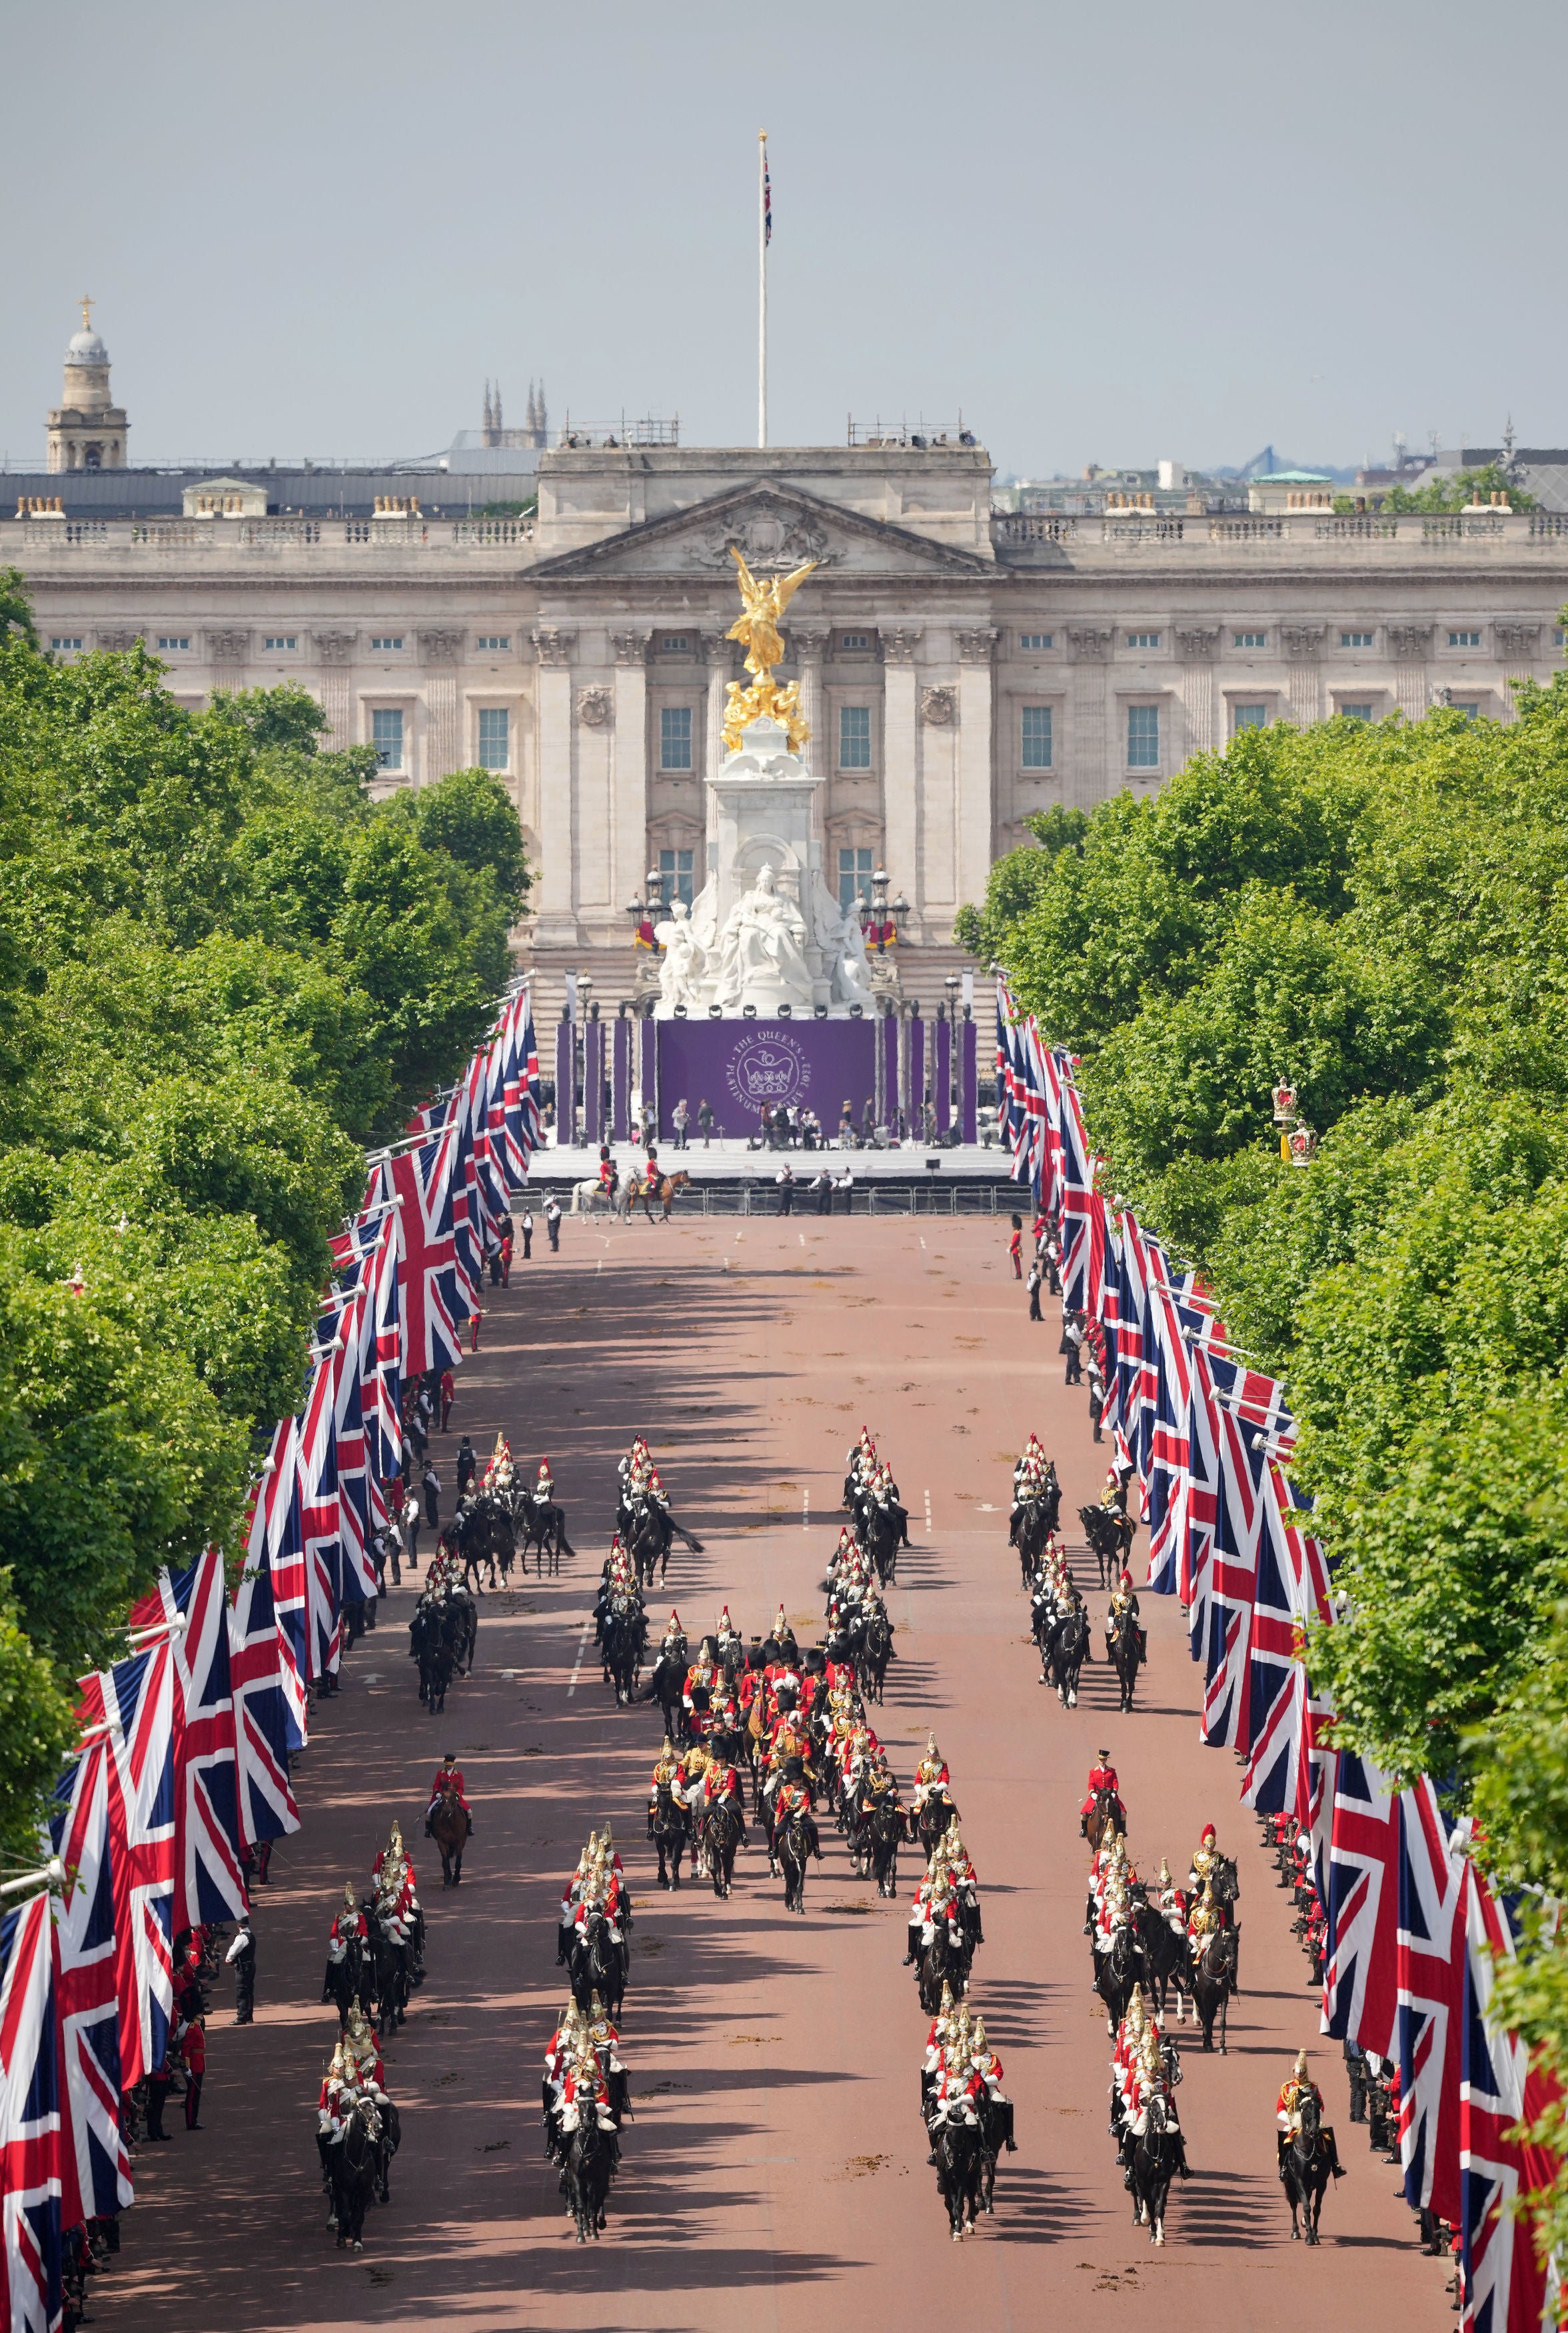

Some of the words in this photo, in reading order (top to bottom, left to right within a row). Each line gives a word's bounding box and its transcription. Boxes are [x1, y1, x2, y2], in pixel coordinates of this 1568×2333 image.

[733, 1035, 754, 1053] THE
[758, 1031, 803, 1054] QUEEN'S
[726, 1064, 760, 1114] PLATINUM
